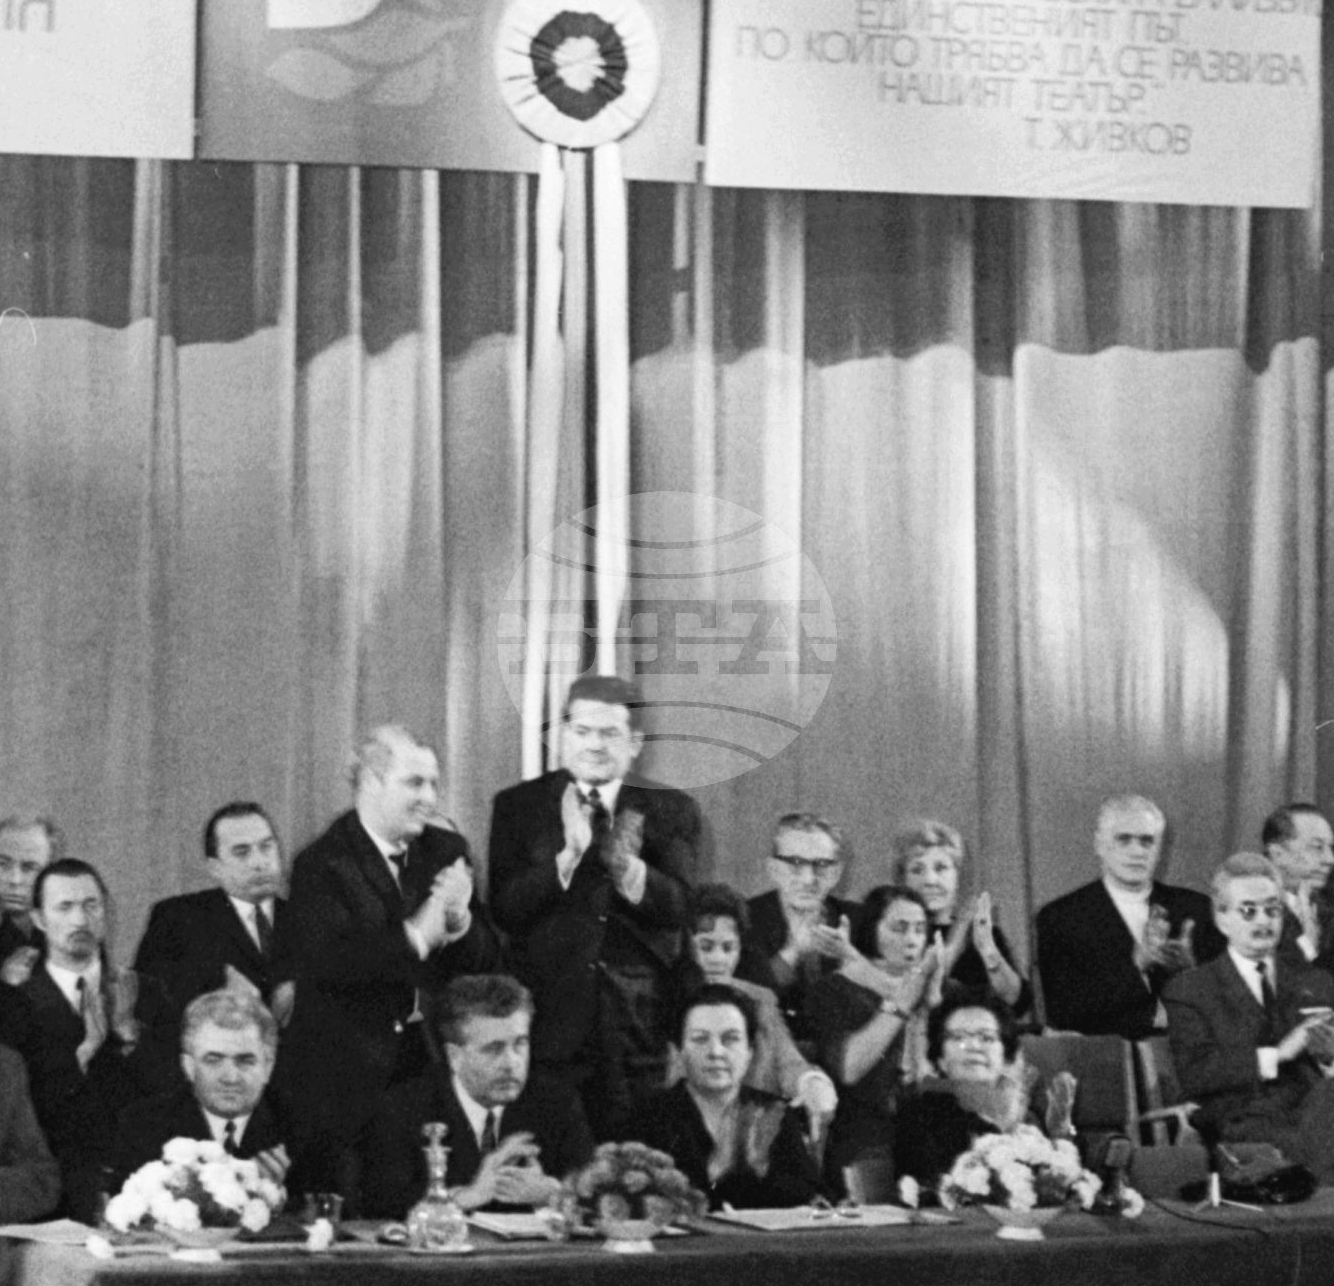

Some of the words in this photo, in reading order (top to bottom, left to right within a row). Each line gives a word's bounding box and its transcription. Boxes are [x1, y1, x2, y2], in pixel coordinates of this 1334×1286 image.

[735, 25, 791, 61] ПО
[930, 36, 1048, 74] ТРЯБВА
[1058, 42, 1108, 78] ДА
[1114, 44, 1159, 80] СЕ
[1169, 48, 1308, 87] РАЗВИВА
[876, 70, 1018, 109] НАШИЯТ
[1051, 119, 1194, 156] ЖИВКОВ
